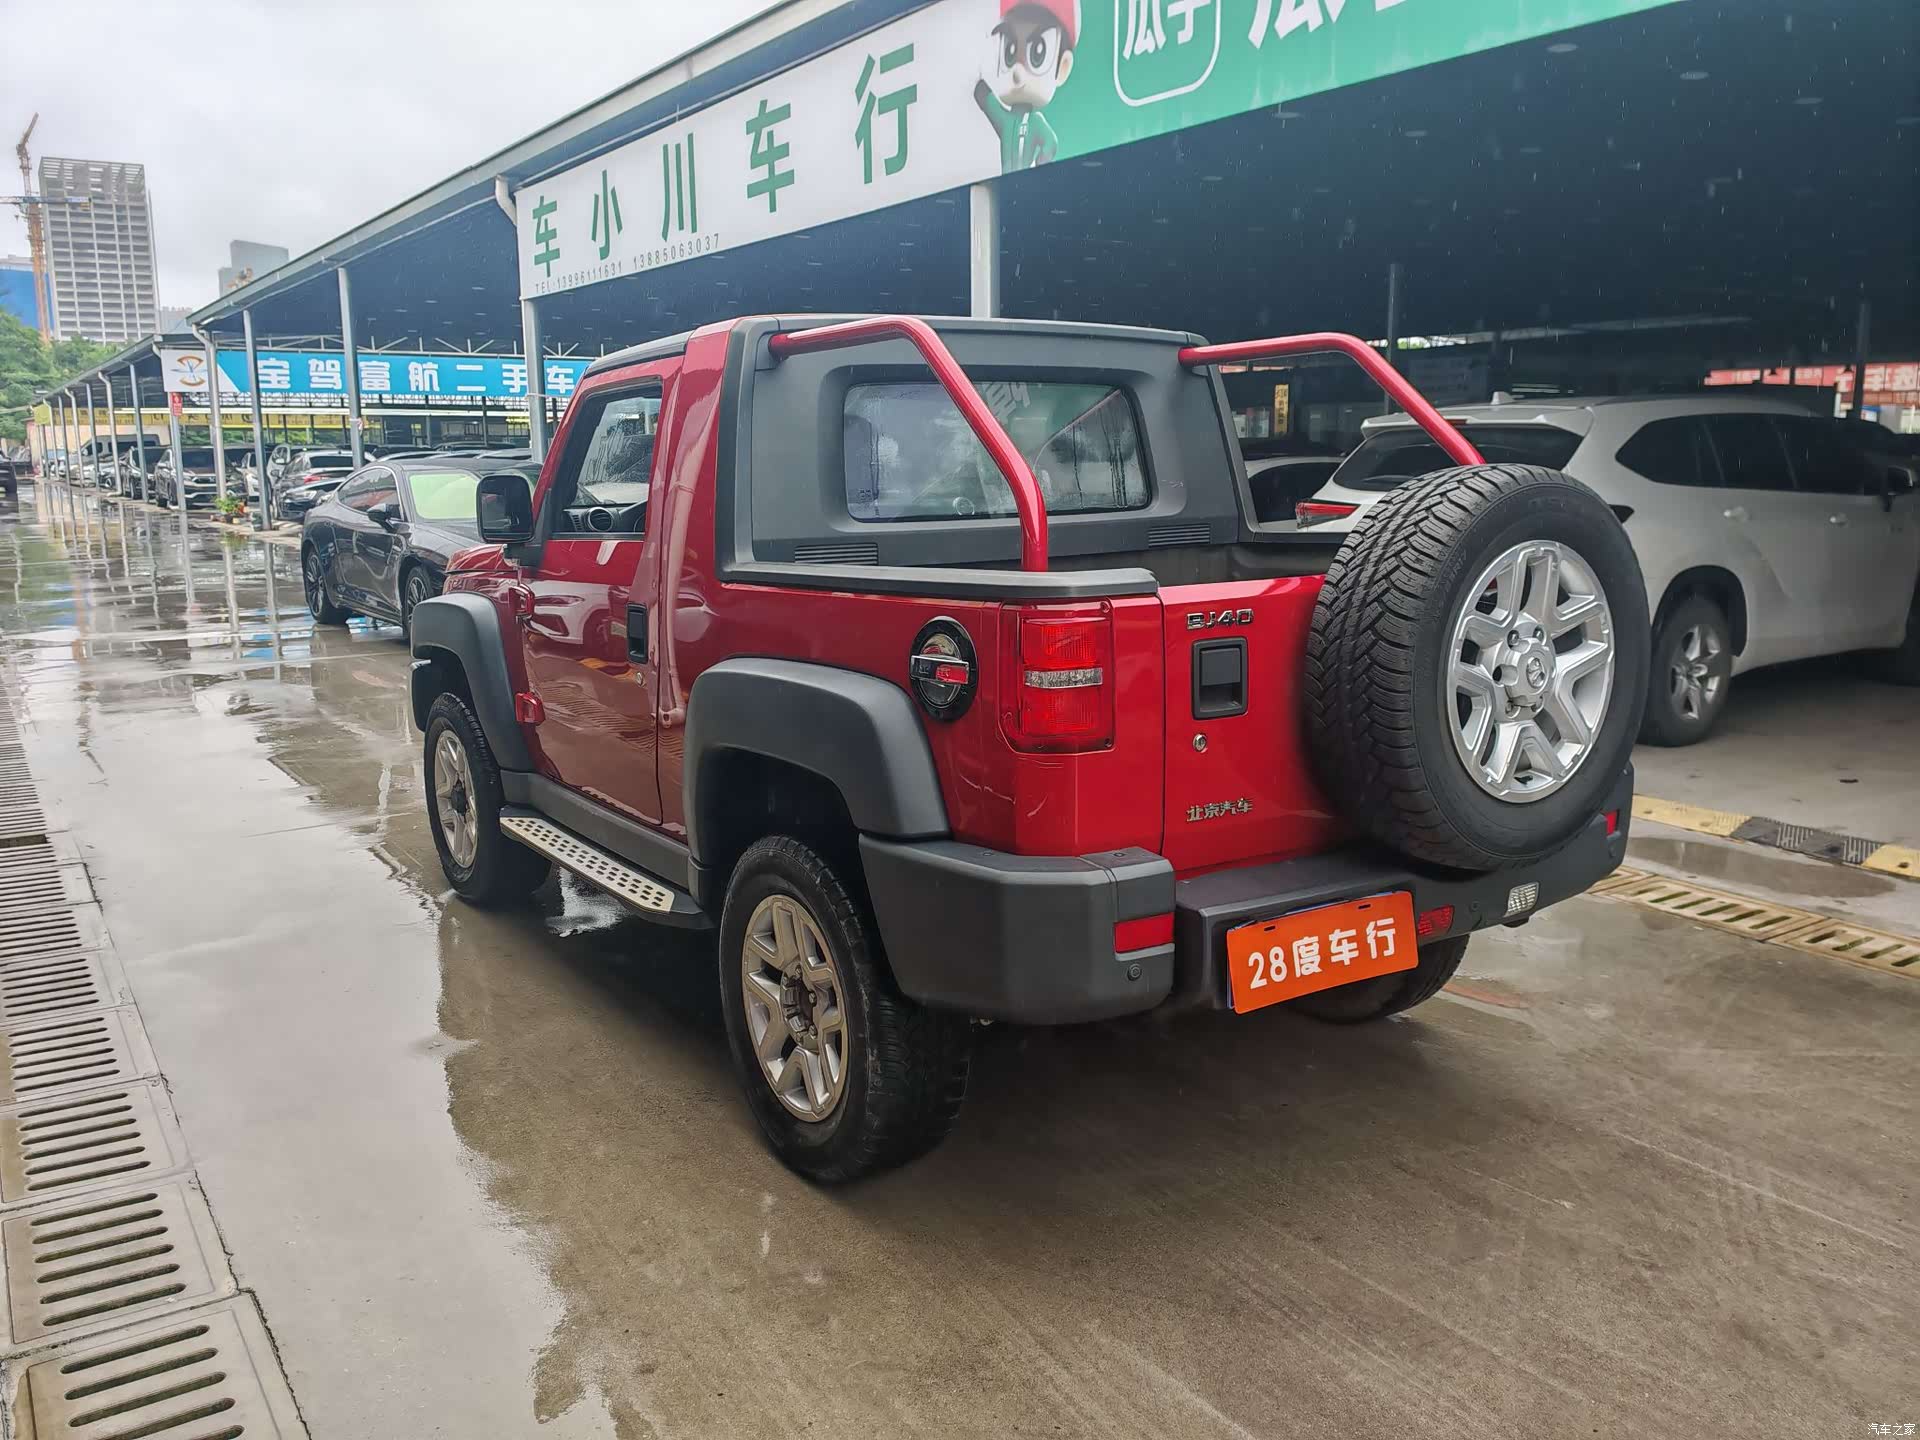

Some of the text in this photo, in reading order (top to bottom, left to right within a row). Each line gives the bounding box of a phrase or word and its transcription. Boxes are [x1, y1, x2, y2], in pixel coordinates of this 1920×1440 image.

[532, 43, 918, 278] 车小川车行
[633, 233, 720, 271] 13885063037
[257, 357, 576, 394] 宝驾富航二手车
[1187, 608, 1254, 630] BJ40
[1186, 797, 1254, 822] 北京汽车
[1247, 917, 1397, 990] 28度车行
